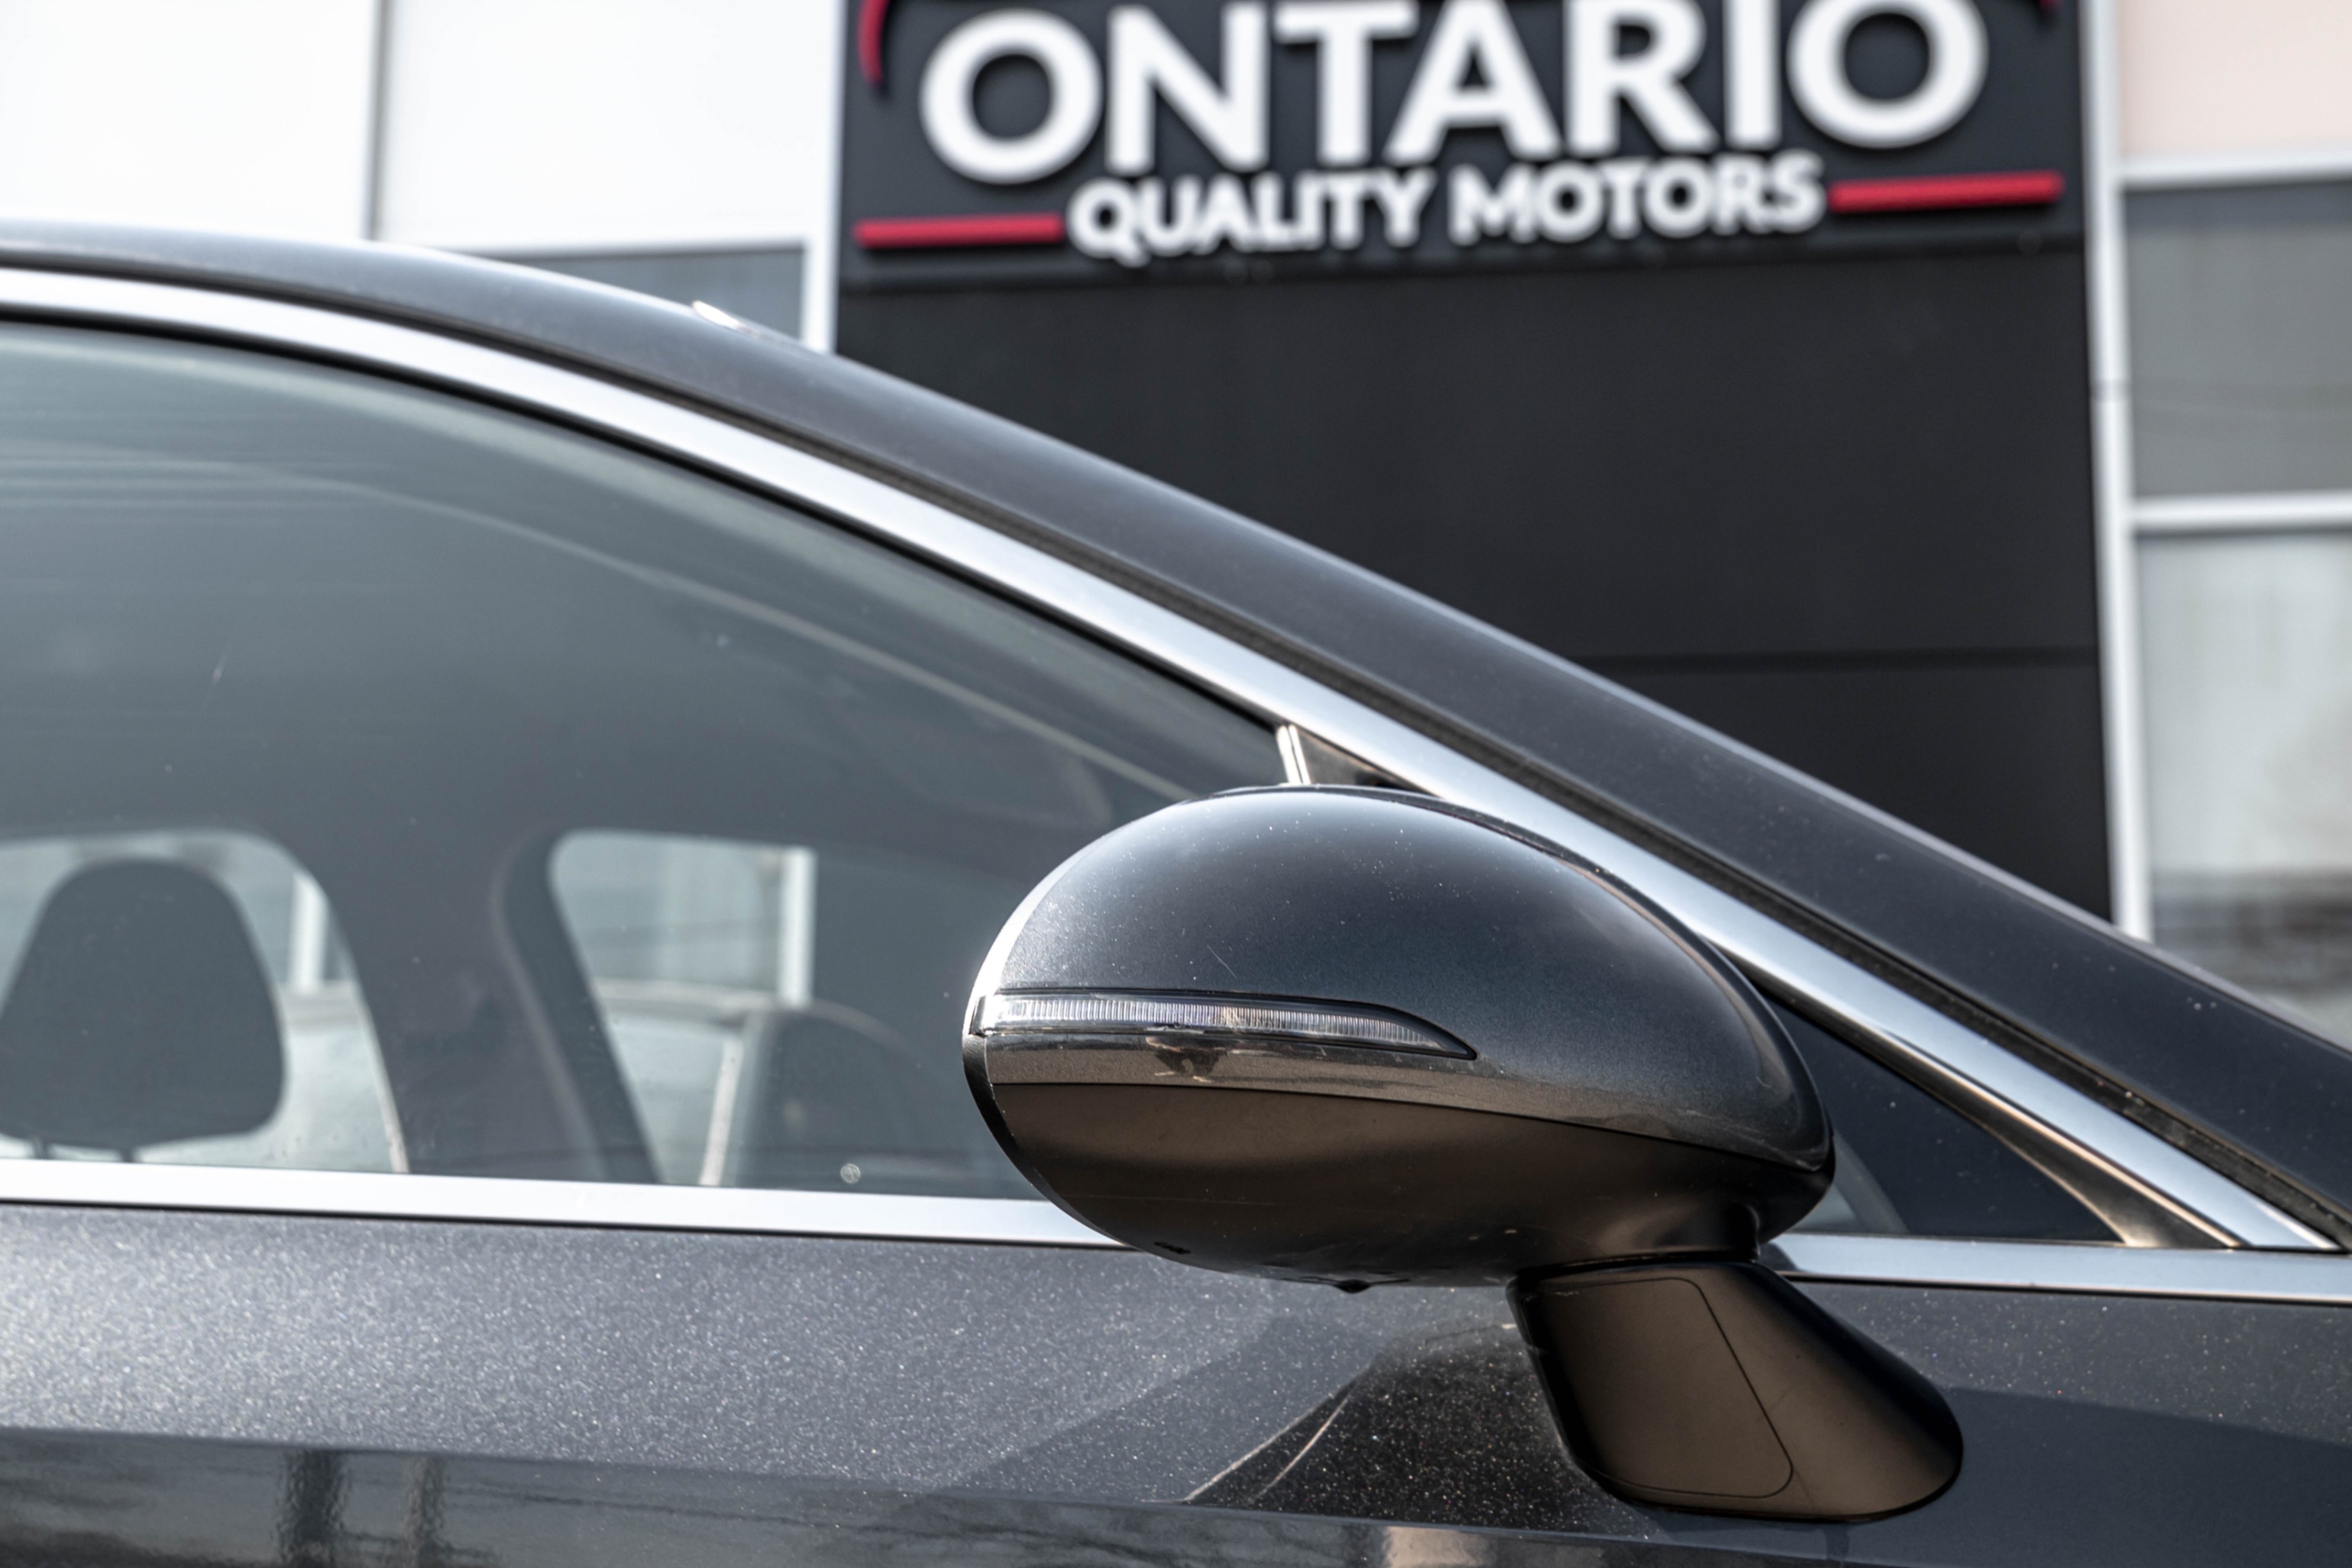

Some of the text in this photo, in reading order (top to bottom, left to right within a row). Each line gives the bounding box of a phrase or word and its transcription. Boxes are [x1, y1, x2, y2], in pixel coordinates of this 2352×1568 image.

[920, 0, 1987, 182] ONTARIO
[1067, 151, 1824, 265] QUALITY MOTORS
